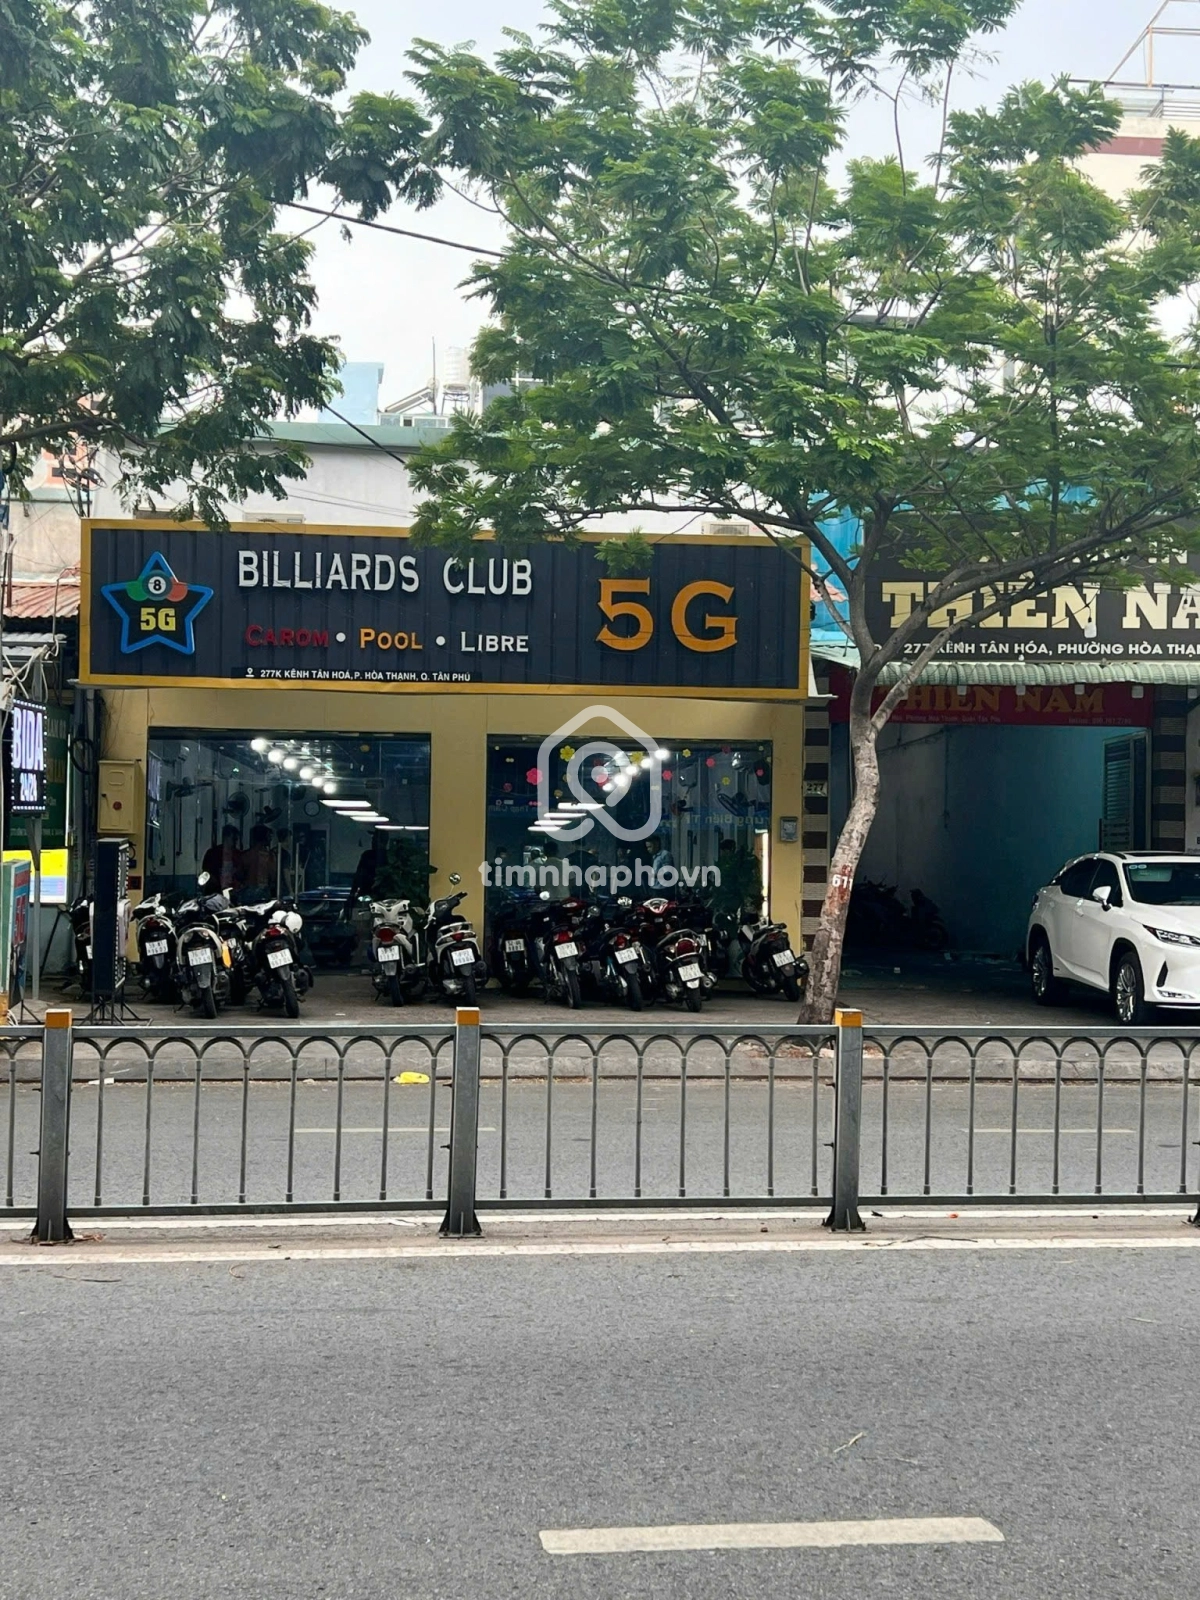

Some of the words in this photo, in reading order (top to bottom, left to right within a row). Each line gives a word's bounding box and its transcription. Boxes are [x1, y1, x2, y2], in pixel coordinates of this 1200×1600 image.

[237, 550, 420, 593] BILLIARDS
[442, 557, 533, 596] CLUB
[139, 607, 177, 632] 5G
[595, 577, 739, 653] 5G
[244, 623, 330, 648] CAROM
[359, 627, 423, 651] POOL
[460, 630, 530, 653] LIBRE
[979, 640, 1010, 654] TÂN
[1013, 640, 1053, 656] HÓA,
[1057, 640, 1125, 655] PHƯỜNG
[1127, 640, 1164, 655] HÒA
[260, 669, 282, 678] 277K
[284, 668, 310, 679] KÊNH
[311, 668, 330, 679] TÂN
[365, 670, 384, 680] HÒA
[386, 672, 419, 682] THẠNH,
[433, 671, 451, 681] TÂN
[452, 672, 471, 682] PHÚ
[13, 707, 44, 771] BIDA
